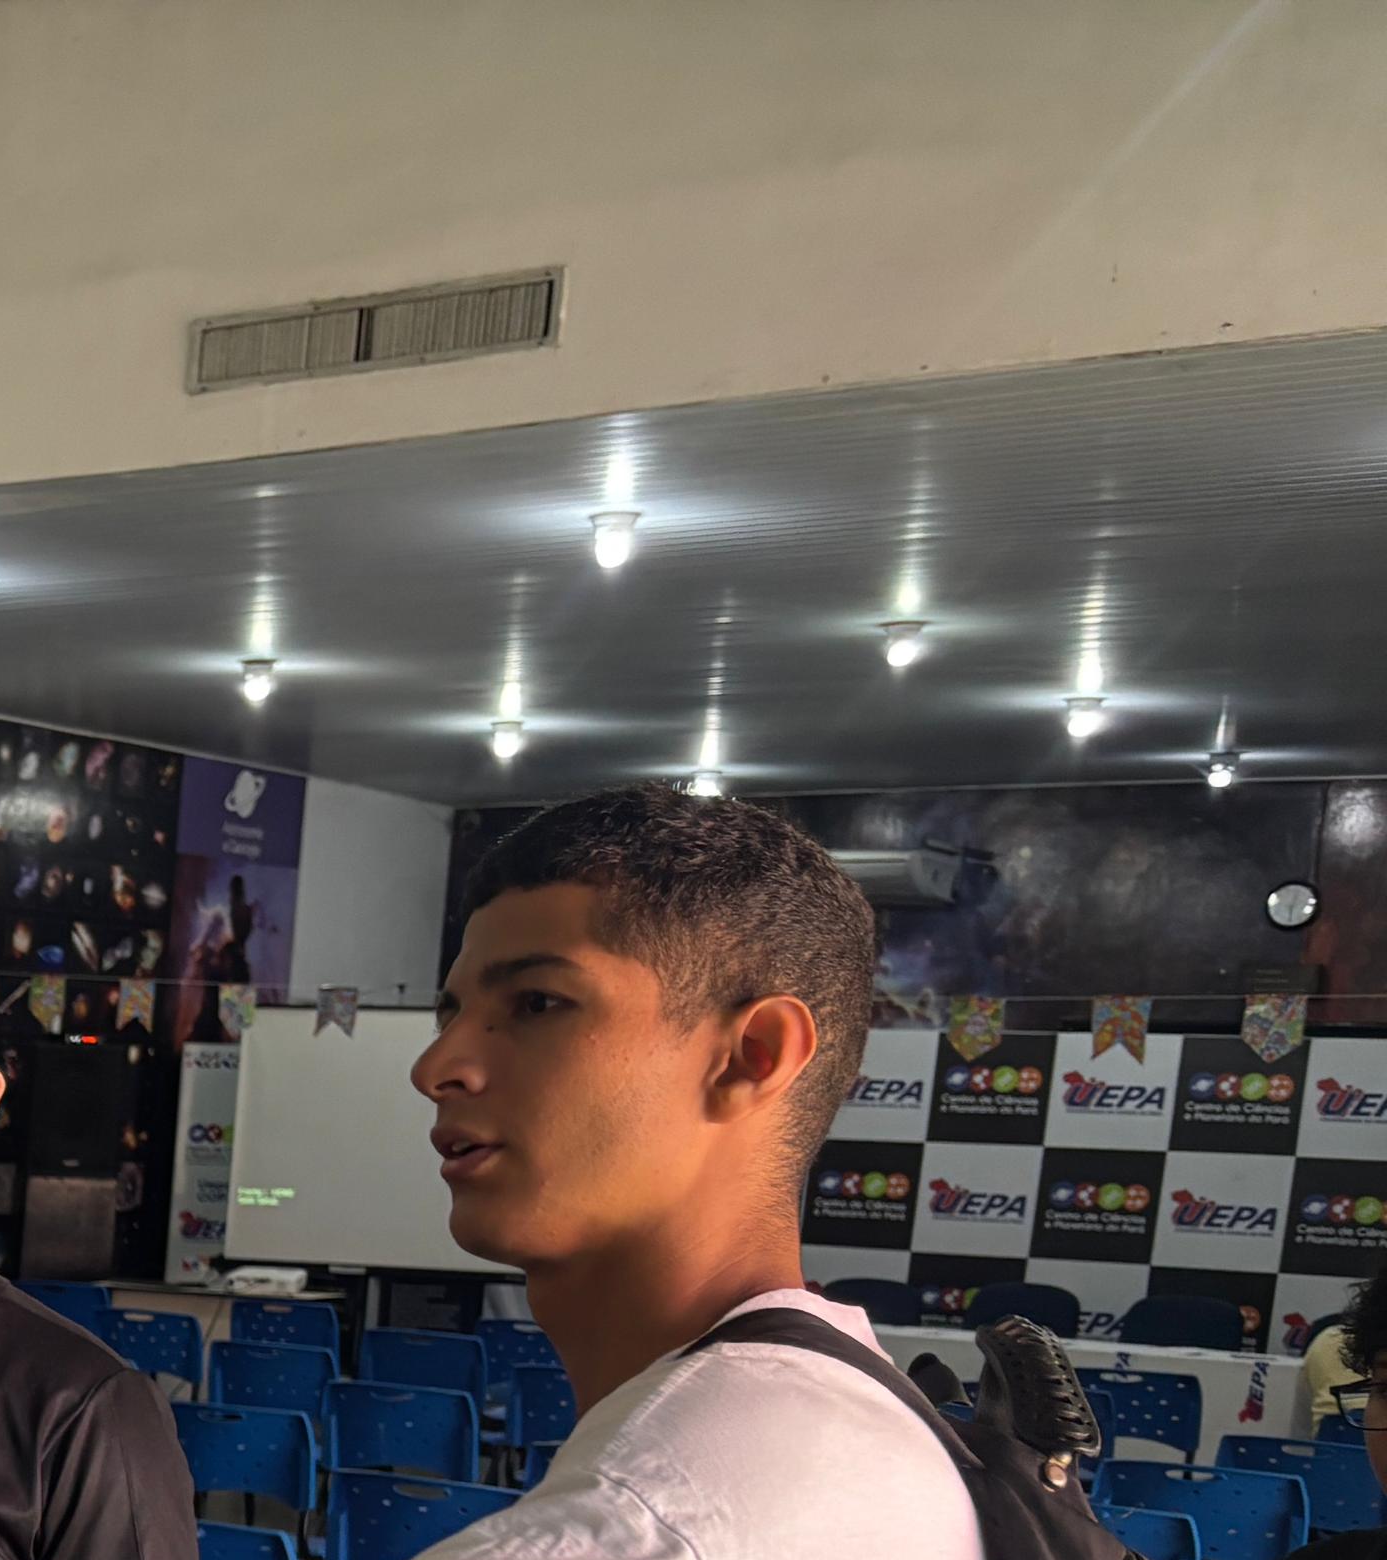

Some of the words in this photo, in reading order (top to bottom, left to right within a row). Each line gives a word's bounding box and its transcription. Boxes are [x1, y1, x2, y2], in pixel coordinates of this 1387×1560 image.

[1065, 1075, 1167, 1110] UEPA
[1317, 1080, 1387, 1117] UE
[931, 1181, 1027, 1218] UEPA
[1173, 1192, 1278, 1230] UEPA
